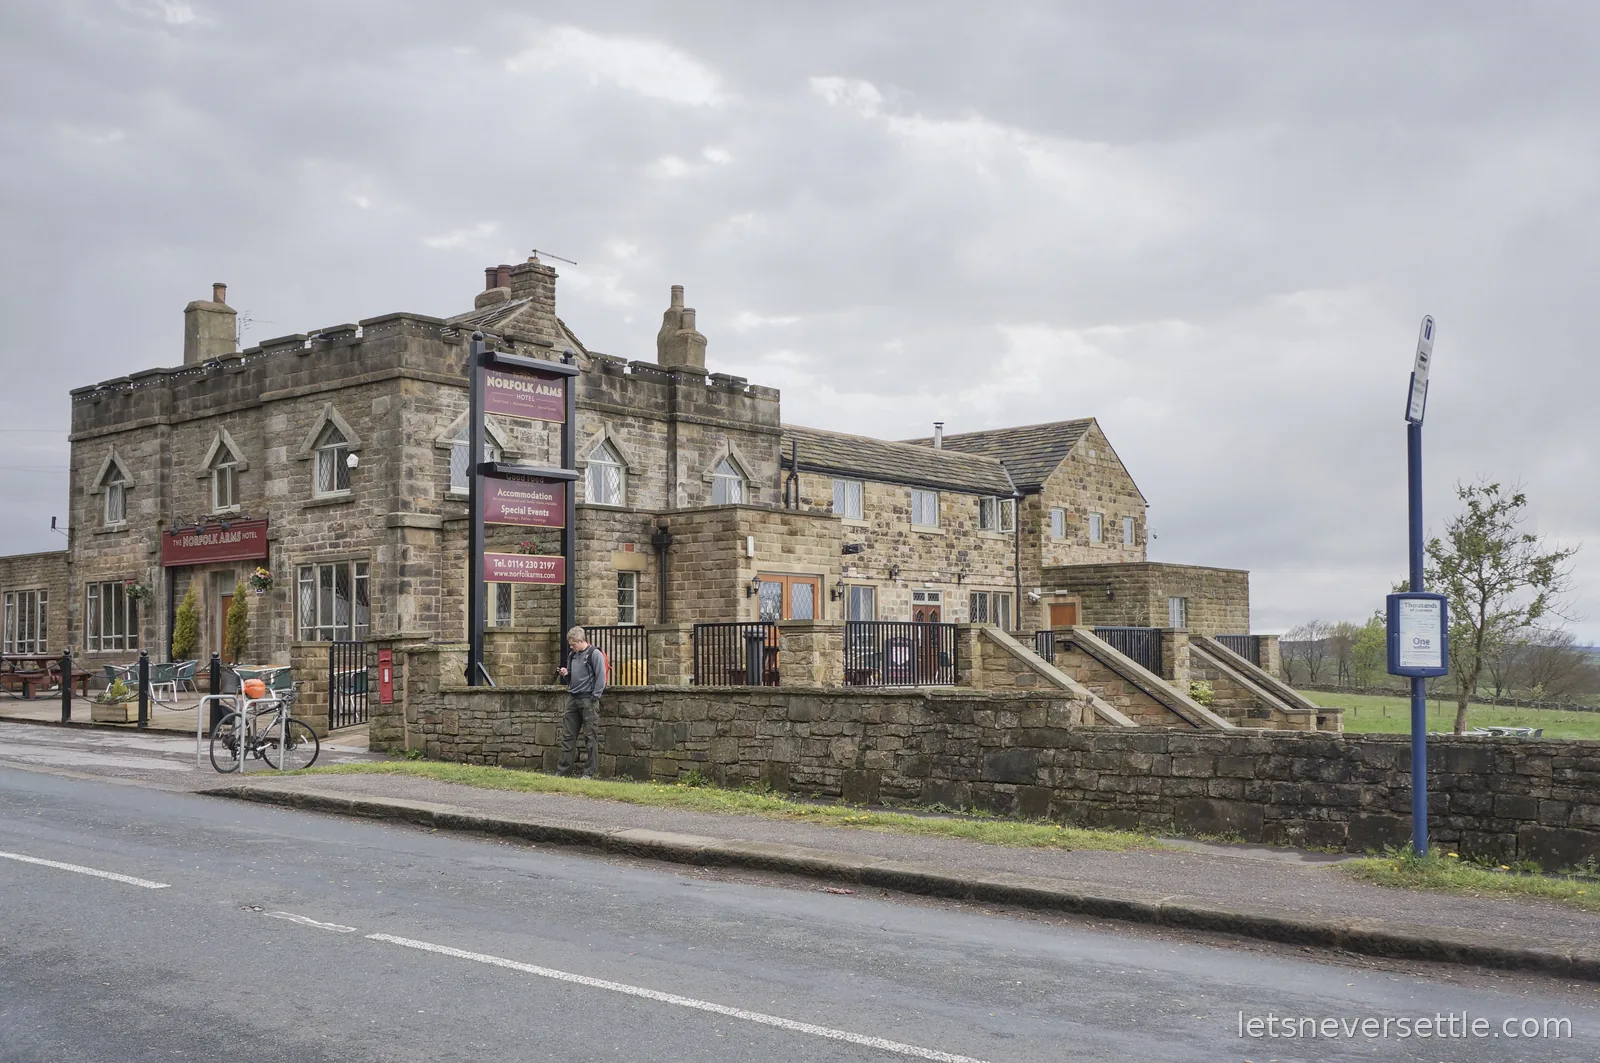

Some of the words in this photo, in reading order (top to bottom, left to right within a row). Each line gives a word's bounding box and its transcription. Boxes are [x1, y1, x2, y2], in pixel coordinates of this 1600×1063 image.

[487, 376, 535, 393] NORFOLK
[536, 384, 562, 398] ARMS
[516, 393, 535, 402] HOTEL
[497, 488, 553, 501] Accommodation
[500, 504, 526, 515] Special
[527, 507, 549, 517] Events
[182, 533, 218, 547] NORFOLK
[219, 531, 241, 544] ARMS
[242, 531, 257, 539] HOTEL
[493, 559, 506, 568] Tel.
[507, 560, 524, 568] 0114
[525, 561, 538, 569] 230
[539, 561, 556, 570] 2197
[493, 570, 556, 579] www.norfolkarms.com
[1413, 637, 1430, 645] One
